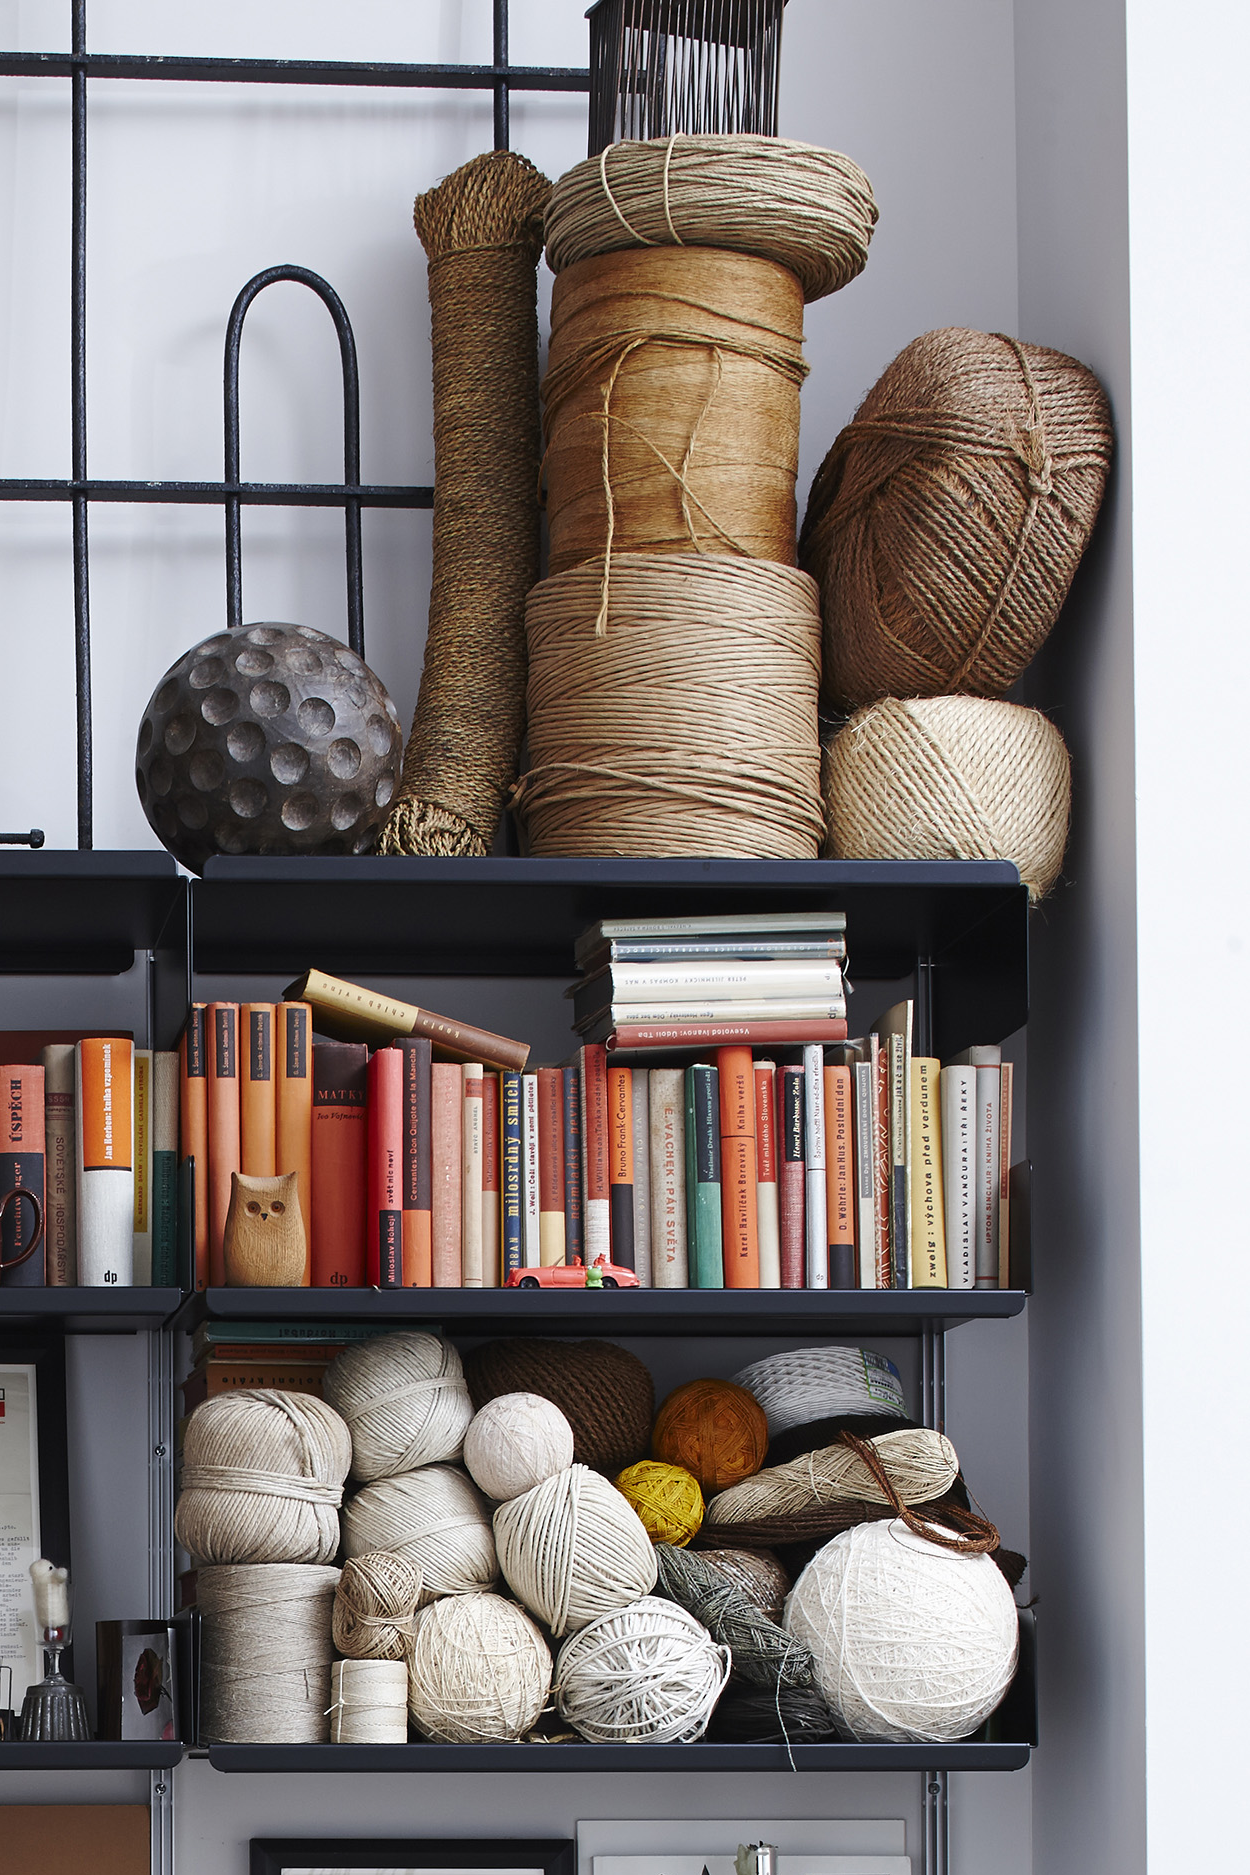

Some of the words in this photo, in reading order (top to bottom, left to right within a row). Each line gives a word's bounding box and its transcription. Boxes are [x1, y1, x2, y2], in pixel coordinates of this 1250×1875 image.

[102, 1043, 115, 1088] vzpomínek
[408, 1048, 417, 1081] Mancha
[102, 1088, 113, 1112] kniha
[316, 1087, 366, 1101] MATKY
[408, 1083, 417, 1092] la
[408, 1093, 417, 1105] de
[735, 1073, 746, 1101] veršů
[760, 1080, 769, 1122] Slovenska
[835, 1078, 845, 1096] den
[918, 1064, 930, 1129] verdunem
[6, 1078, 24, 1143] ÚSPĚCH
[408, 1105, 420, 1136] Quijote
[736, 1104, 746, 1130] Kniha
[835, 1097, 846, 1140] Poslední
[103, 1146, 113, 1160] Jan
[408, 1137, 418, 1155] Don
[761, 1122, 770, 1158] mladého
[836, 1141, 846, 1164] Hus.
[922, 1135, 933, 1166] před
[385, 1149, 395, 1169] neví
[736, 1142, 748, 1186] Borovský
[761, 1159, 771, 1177] Tvář
[836, 1165, 847, 1181] Jan
[385, 1170, 395, 1183] nic
[409, 1156, 418, 1202] Cervantes:
[385, 1184, 395, 1205] svět
[837, 1182, 847, 1219] Wöhrle:
[923, 1172, 935, 1226] výchova
[738, 1188, 748, 1230] Havlíček
[386, 1214, 397, 1245] Nohejl
[739, 1232, 748, 1258] Karel
[926, 1240, 938, 1278] zweig
[103, 1270, 118, 1286] dp
[386, 1246, 396, 1283] Miloslav
[329, 1271, 348, 1288] dp
